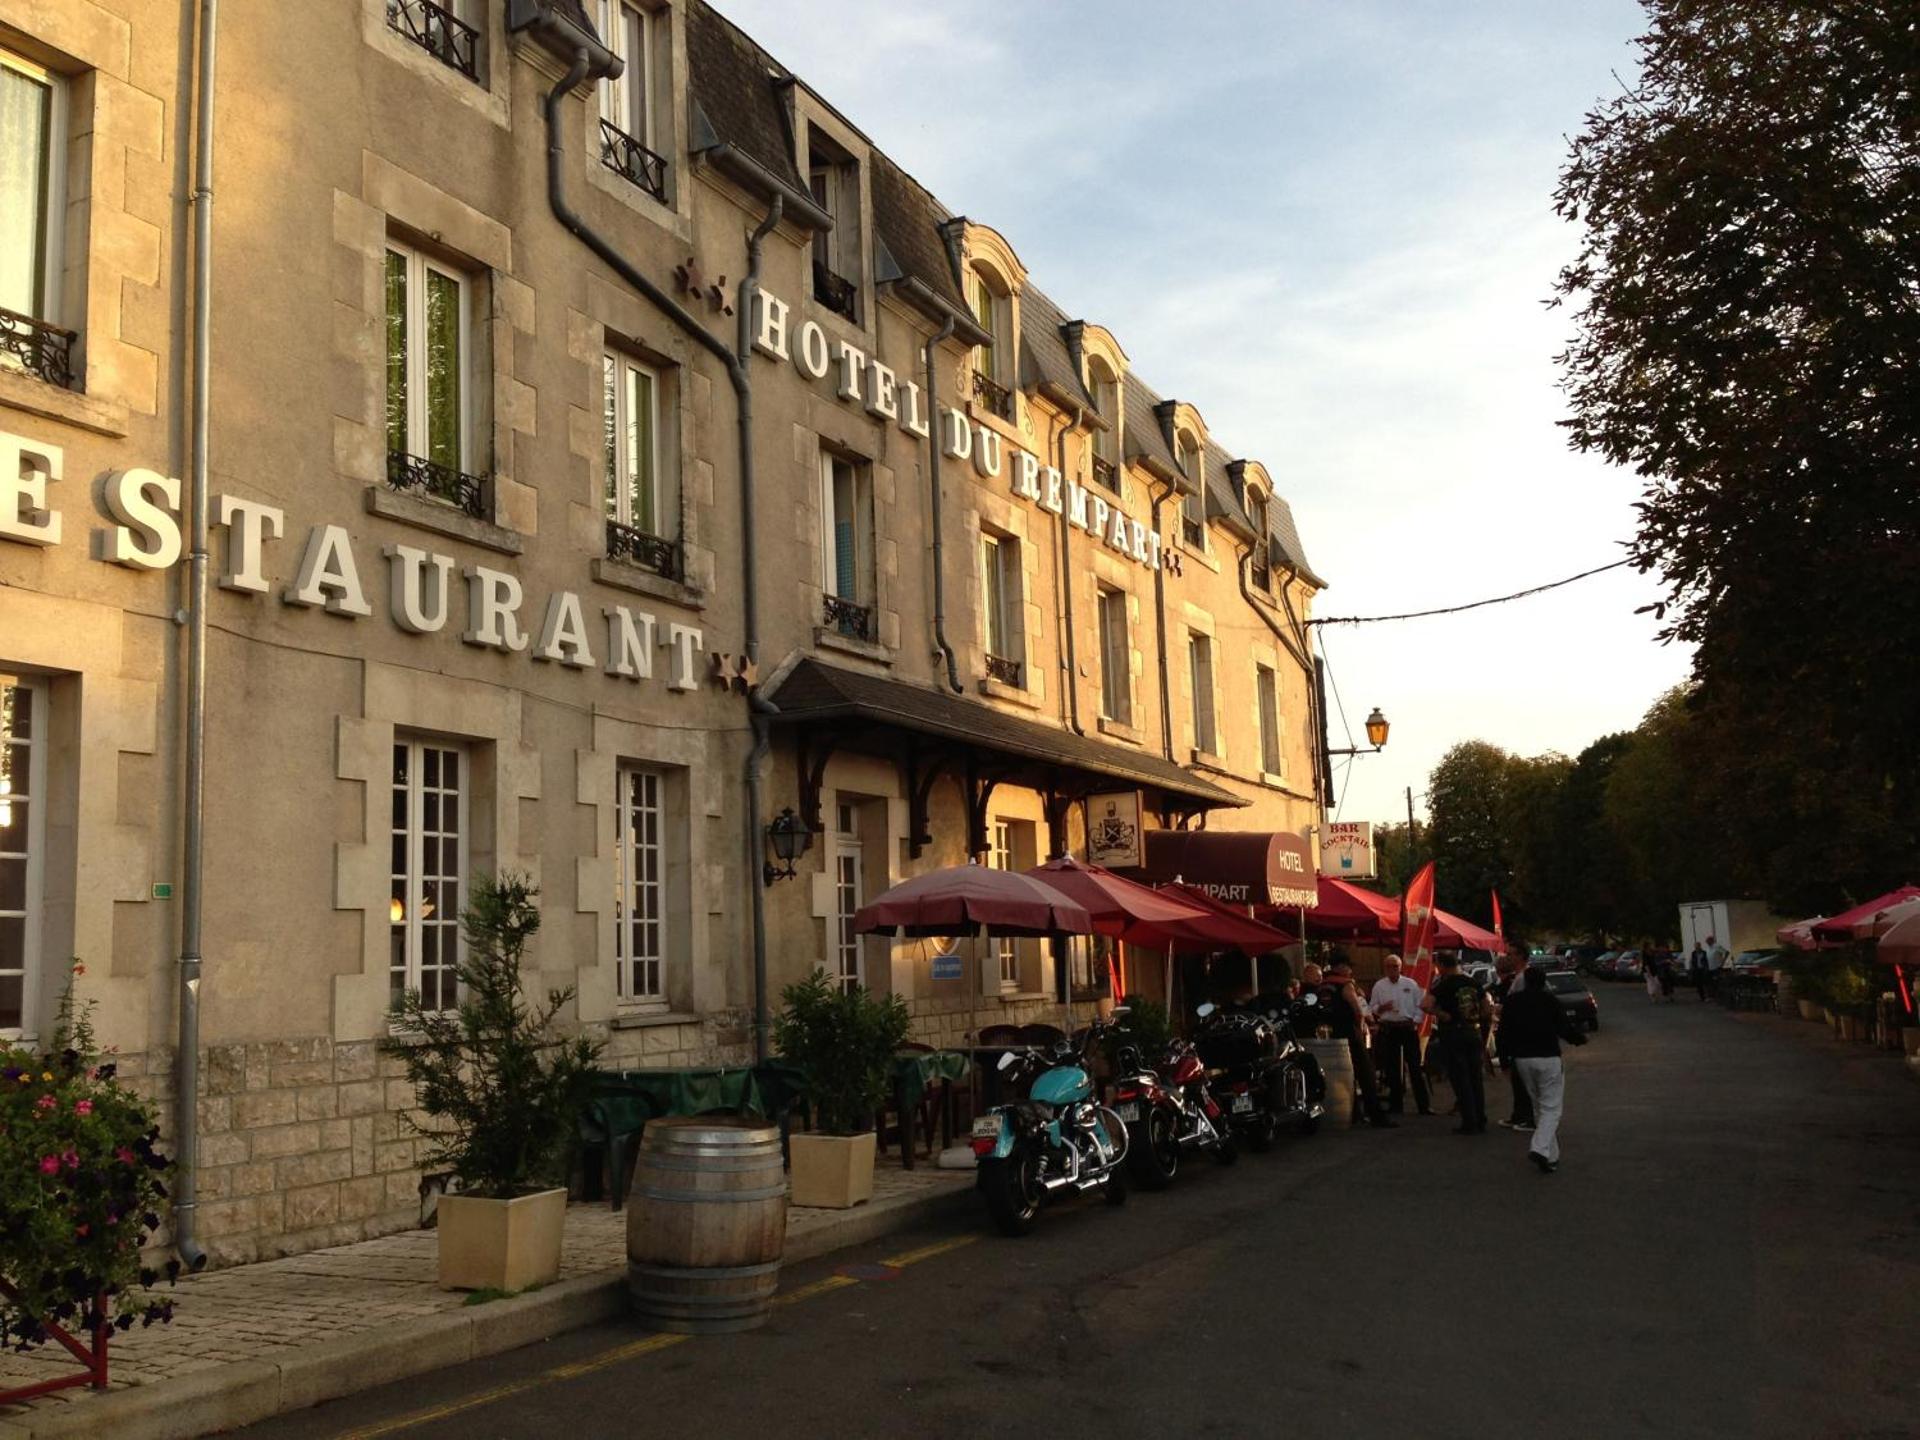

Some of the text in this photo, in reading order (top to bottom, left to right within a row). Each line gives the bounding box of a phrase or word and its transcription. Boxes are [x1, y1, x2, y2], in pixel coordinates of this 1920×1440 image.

[753, 287, 1161, 570] HOTEL DU REMPART
[1330, 823, 1360, 833] BAR
[1322, 834, 1370, 850] COCKTAIL
[1279, 849, 1304, 873] HOTEL
